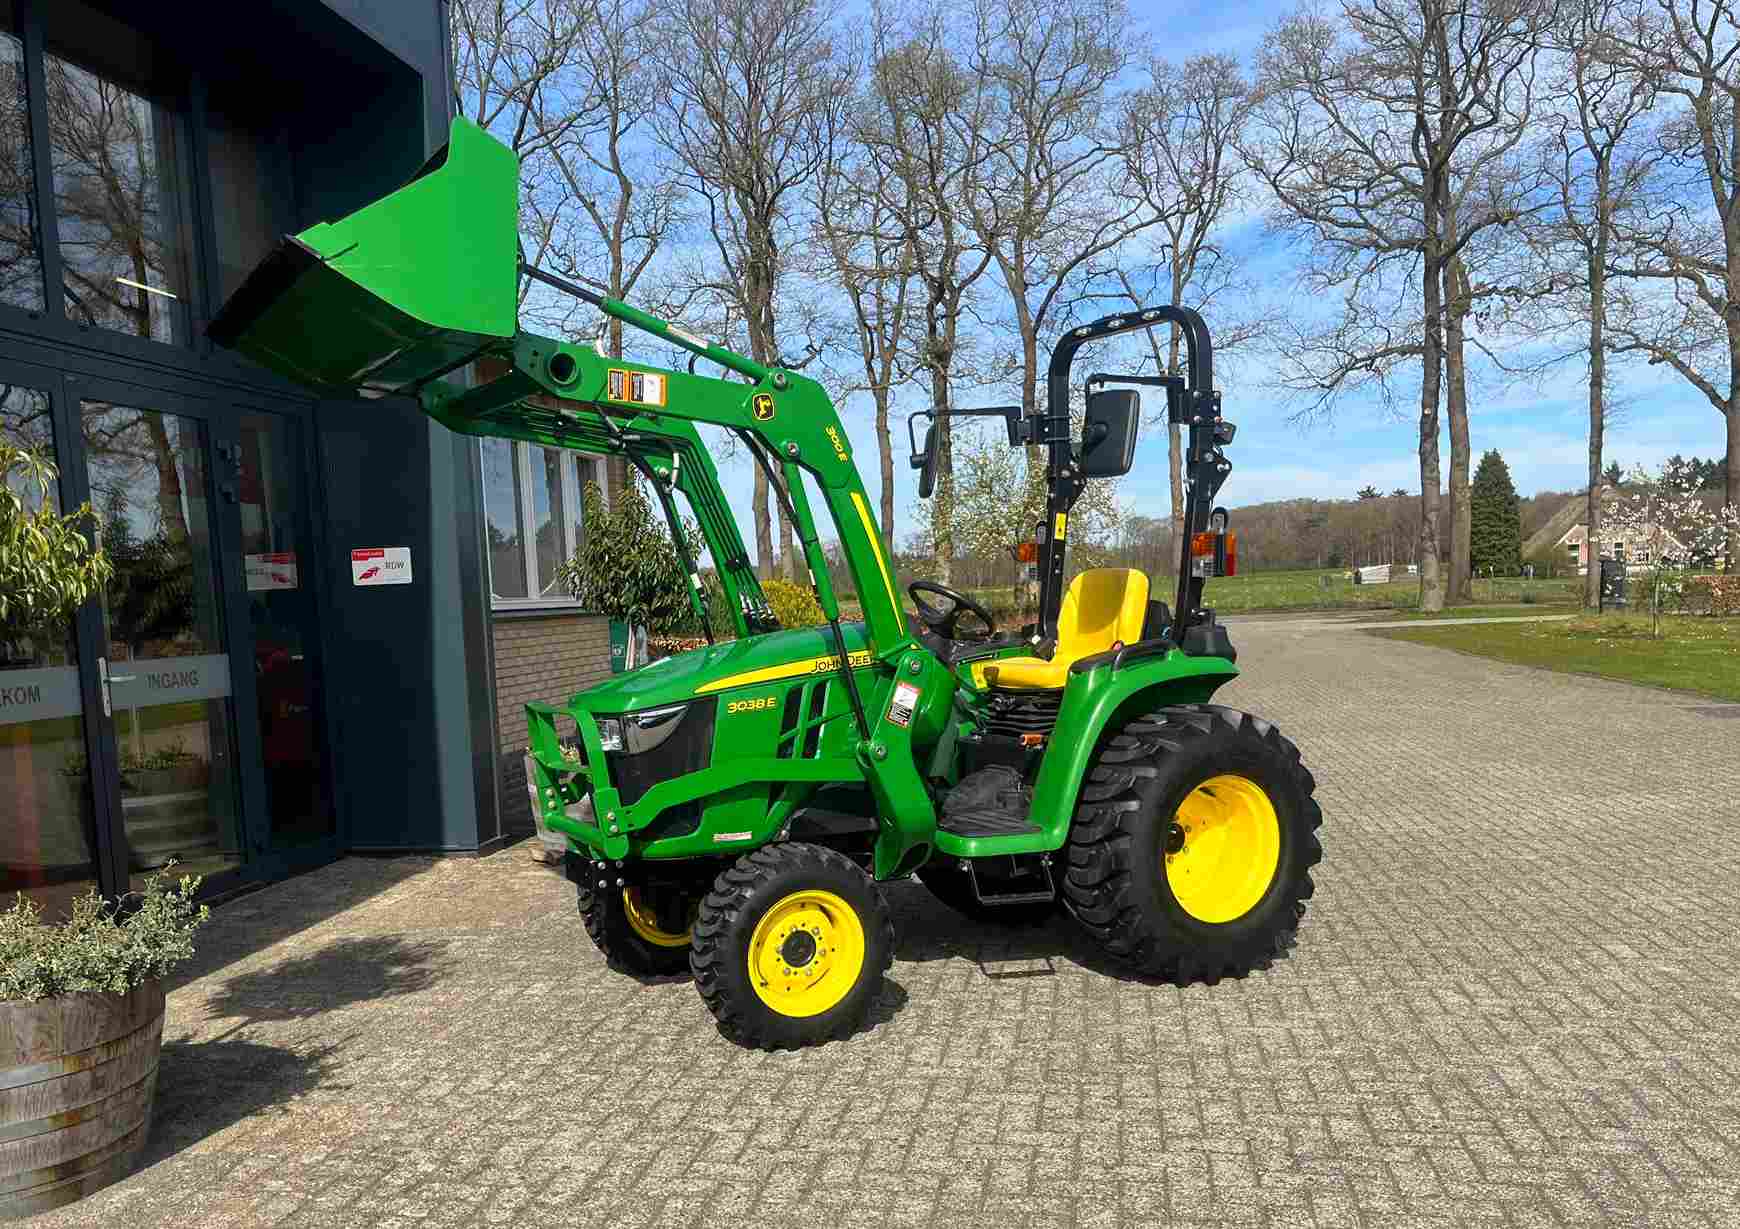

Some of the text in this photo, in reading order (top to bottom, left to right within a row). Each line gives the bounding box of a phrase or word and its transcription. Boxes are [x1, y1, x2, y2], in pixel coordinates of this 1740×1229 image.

[847, 654, 874, 668] DEE
[144, 669, 199, 688] INGANG
[0, 686, 41, 706] KOM
